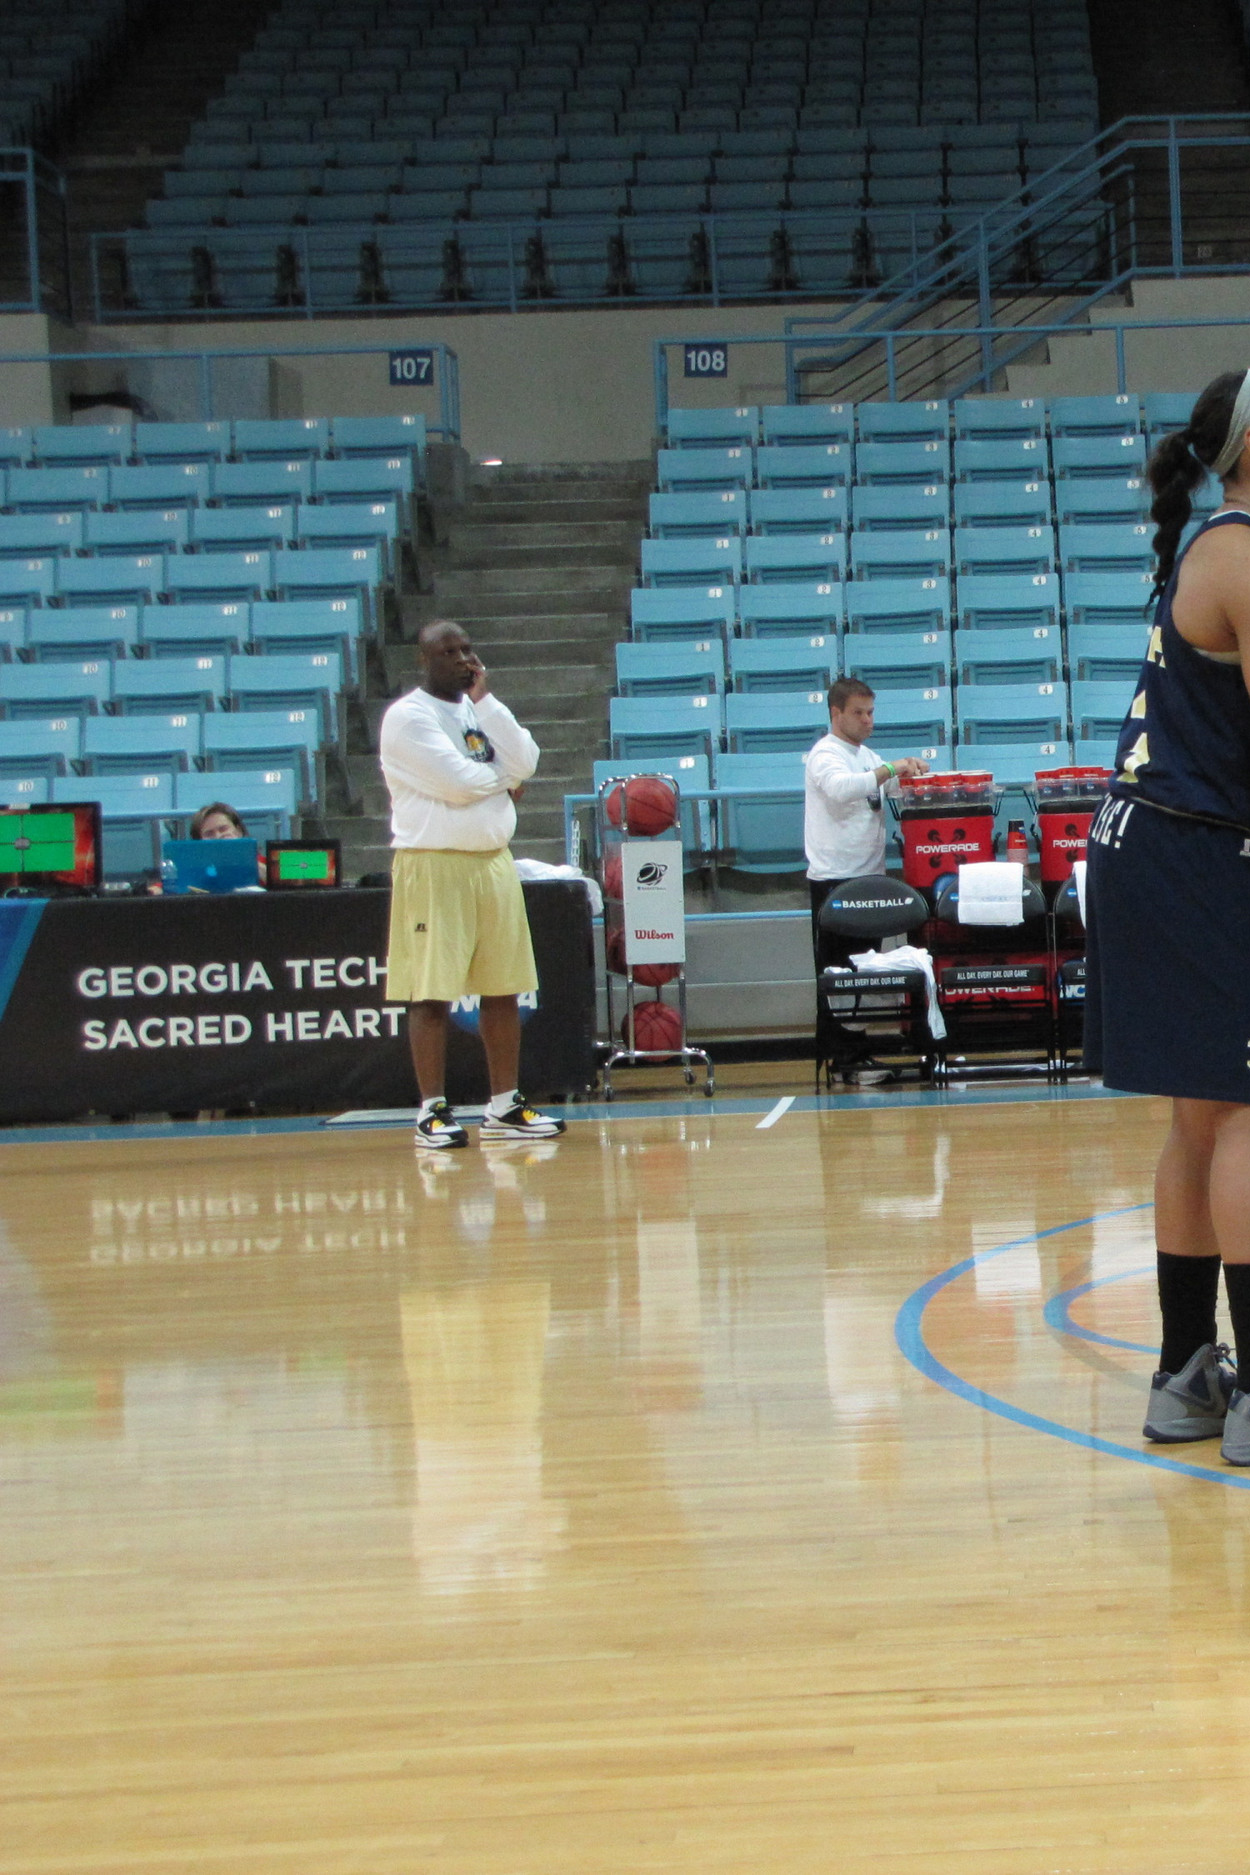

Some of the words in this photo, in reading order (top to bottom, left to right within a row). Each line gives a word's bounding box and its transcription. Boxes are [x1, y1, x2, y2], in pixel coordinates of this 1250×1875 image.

[687, 350, 725, 371] 108
[393, 358, 430, 379] 107
[916, 843, 979, 854] POWERADE
[842, 898, 904, 909] BASKETBALL
[635, 929, 675, 940] Wilson
[78, 961, 273, 998] GEORGIA
[957, 972, 966, 980] ALL
[1003, 970, 1014, 978] OUR
[881, 977, 891, 985] OUR
[84, 1014, 252, 1050] SACRED
[266, 1007, 406, 1043] HEART
